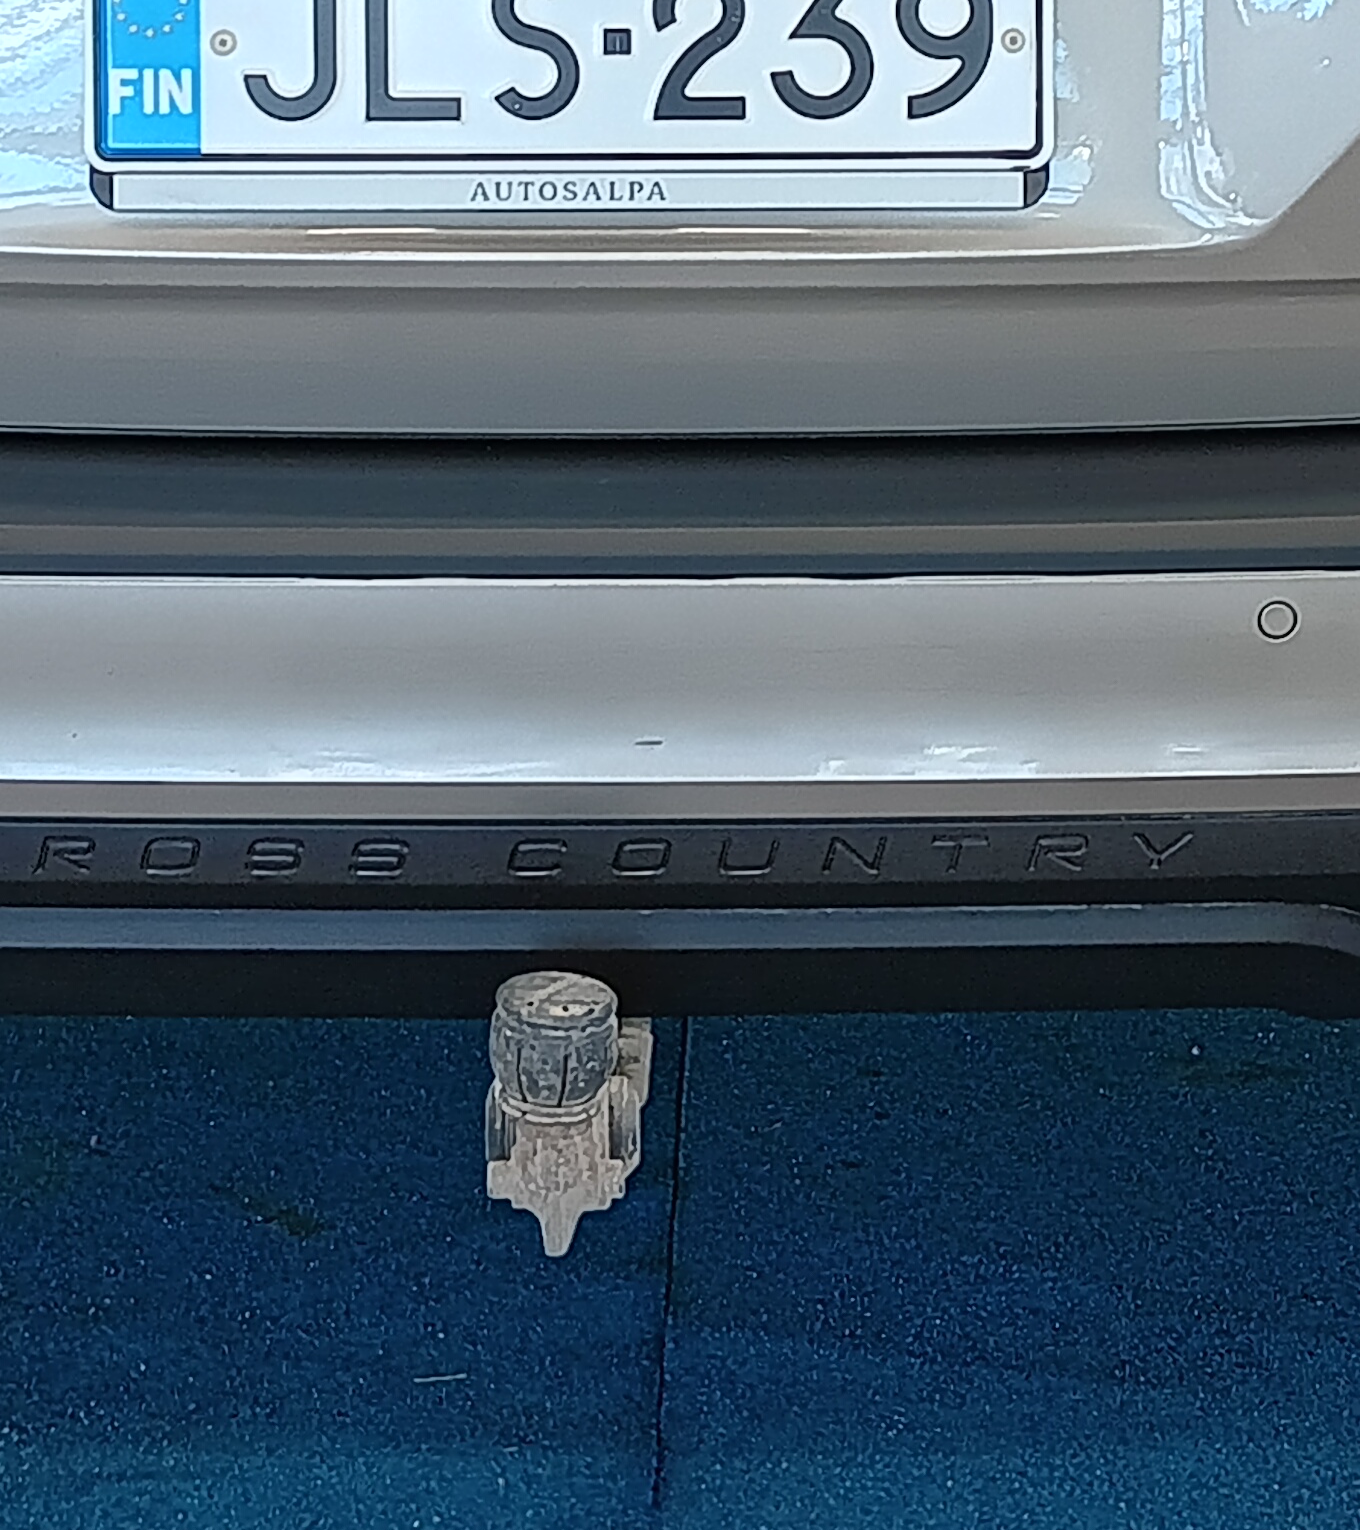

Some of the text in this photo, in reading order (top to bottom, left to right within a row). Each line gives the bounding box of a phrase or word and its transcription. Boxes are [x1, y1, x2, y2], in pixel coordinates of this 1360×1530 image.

[108, 68, 192, 115] FIN
[469, 178, 667, 203] AUTOSALPA
[507, 833, 1194, 877] COUNTRY
